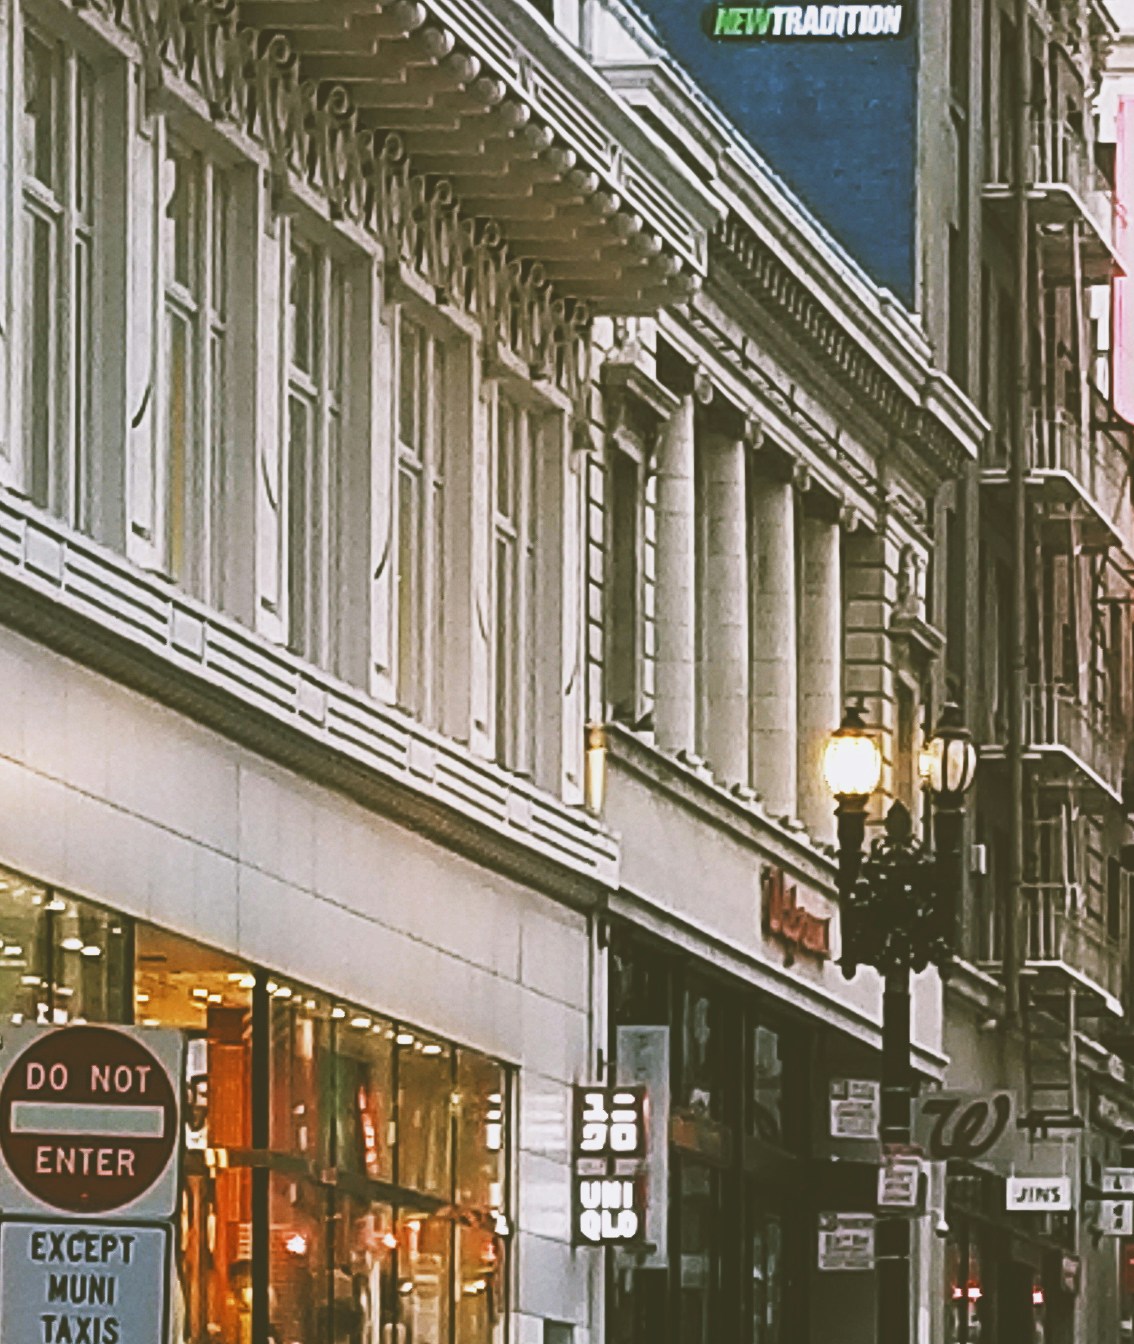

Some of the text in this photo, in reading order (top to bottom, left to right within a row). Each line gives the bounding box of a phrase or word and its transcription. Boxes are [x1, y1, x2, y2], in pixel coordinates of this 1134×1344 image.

[26, 1062, 152, 1093] DO NOT
[36, 1146, 136, 1177] ENTER
[580, 1180, 633, 1209] UNI
[1015, 1186, 1061, 1203] JINS
[31, 1231, 136, 1264] EXCEPT
[48, 1273, 116, 1305] MUNI
